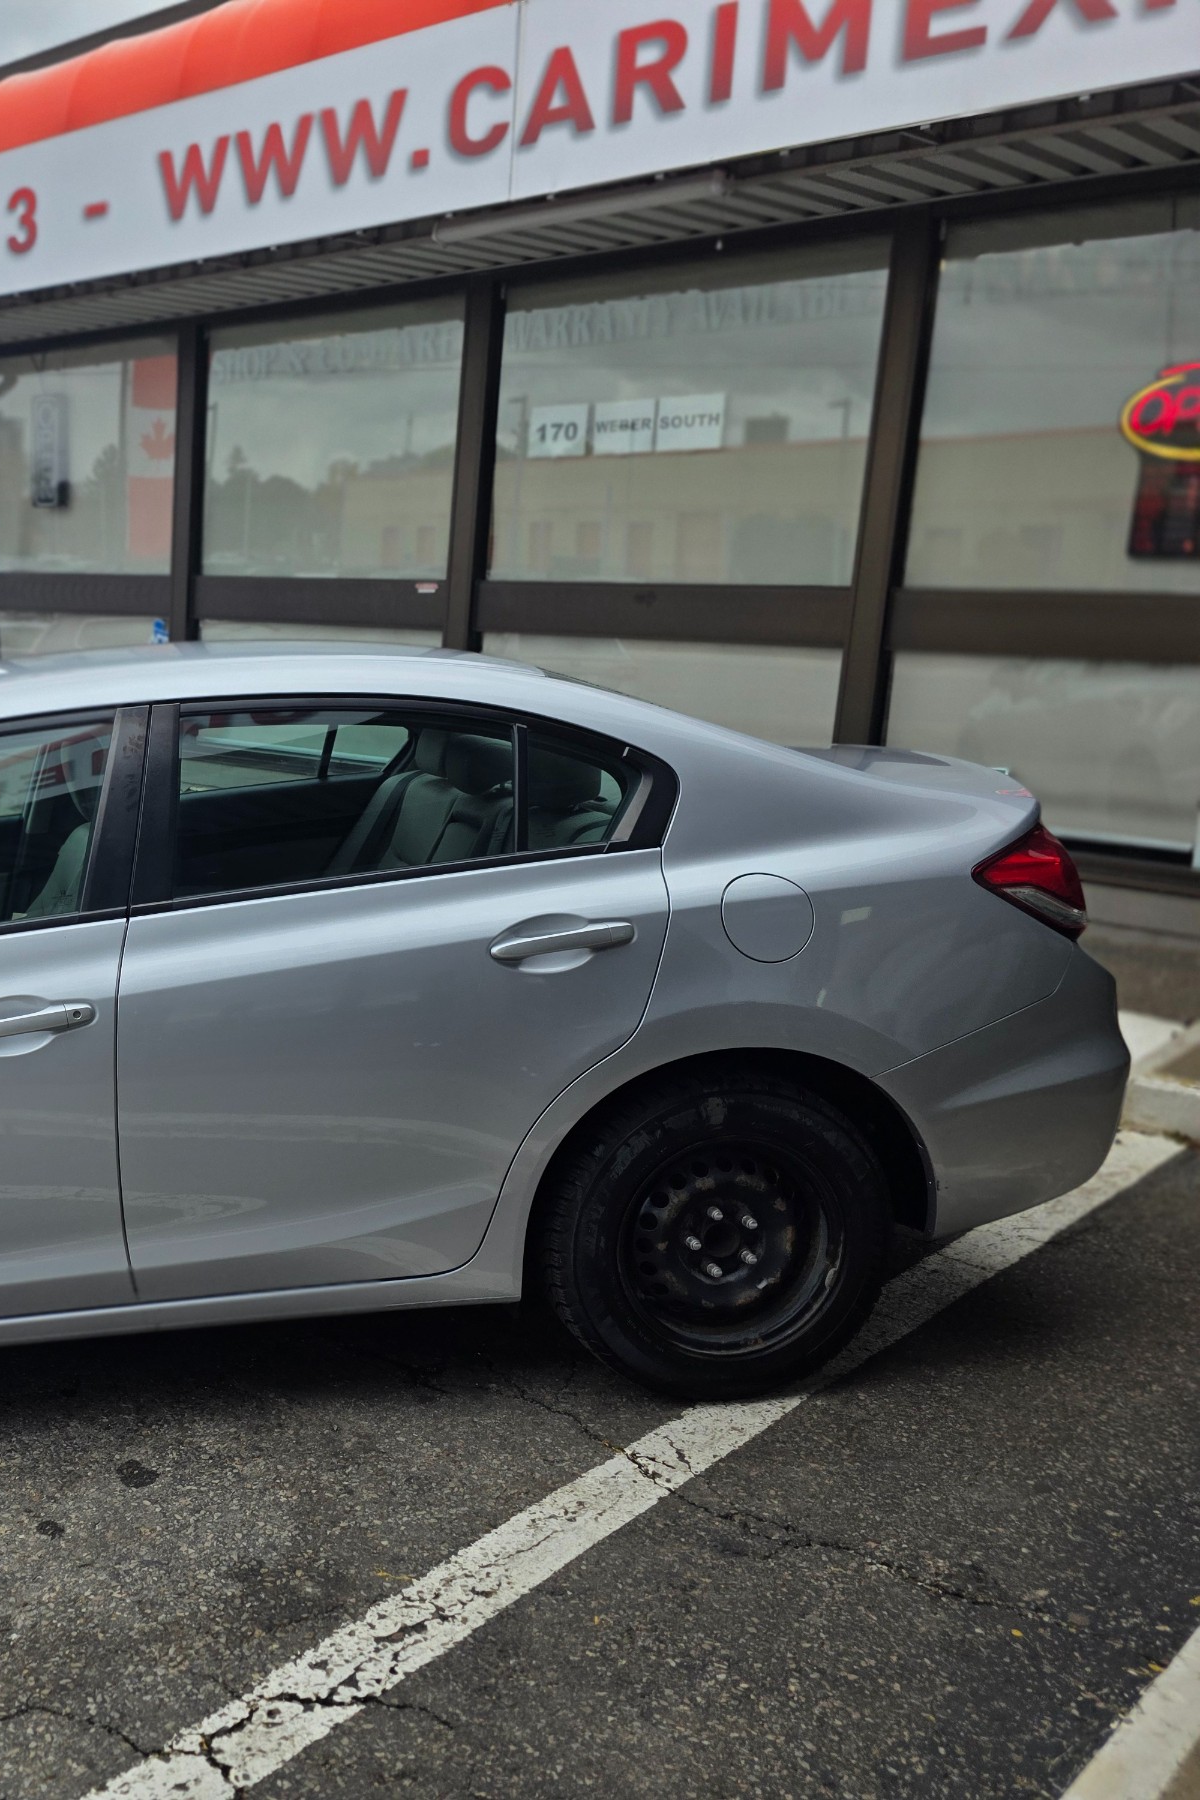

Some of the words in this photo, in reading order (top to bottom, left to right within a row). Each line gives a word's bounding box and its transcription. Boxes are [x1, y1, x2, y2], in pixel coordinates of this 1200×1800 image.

[158, 0, 1178, 222] WWW.CARIME
[536, 421, 579, 443] 170
[595, 416, 652, 434] WEBER
[659, 412, 722, 431] SOUTH
[1129, 384, 1200, 436] OP
